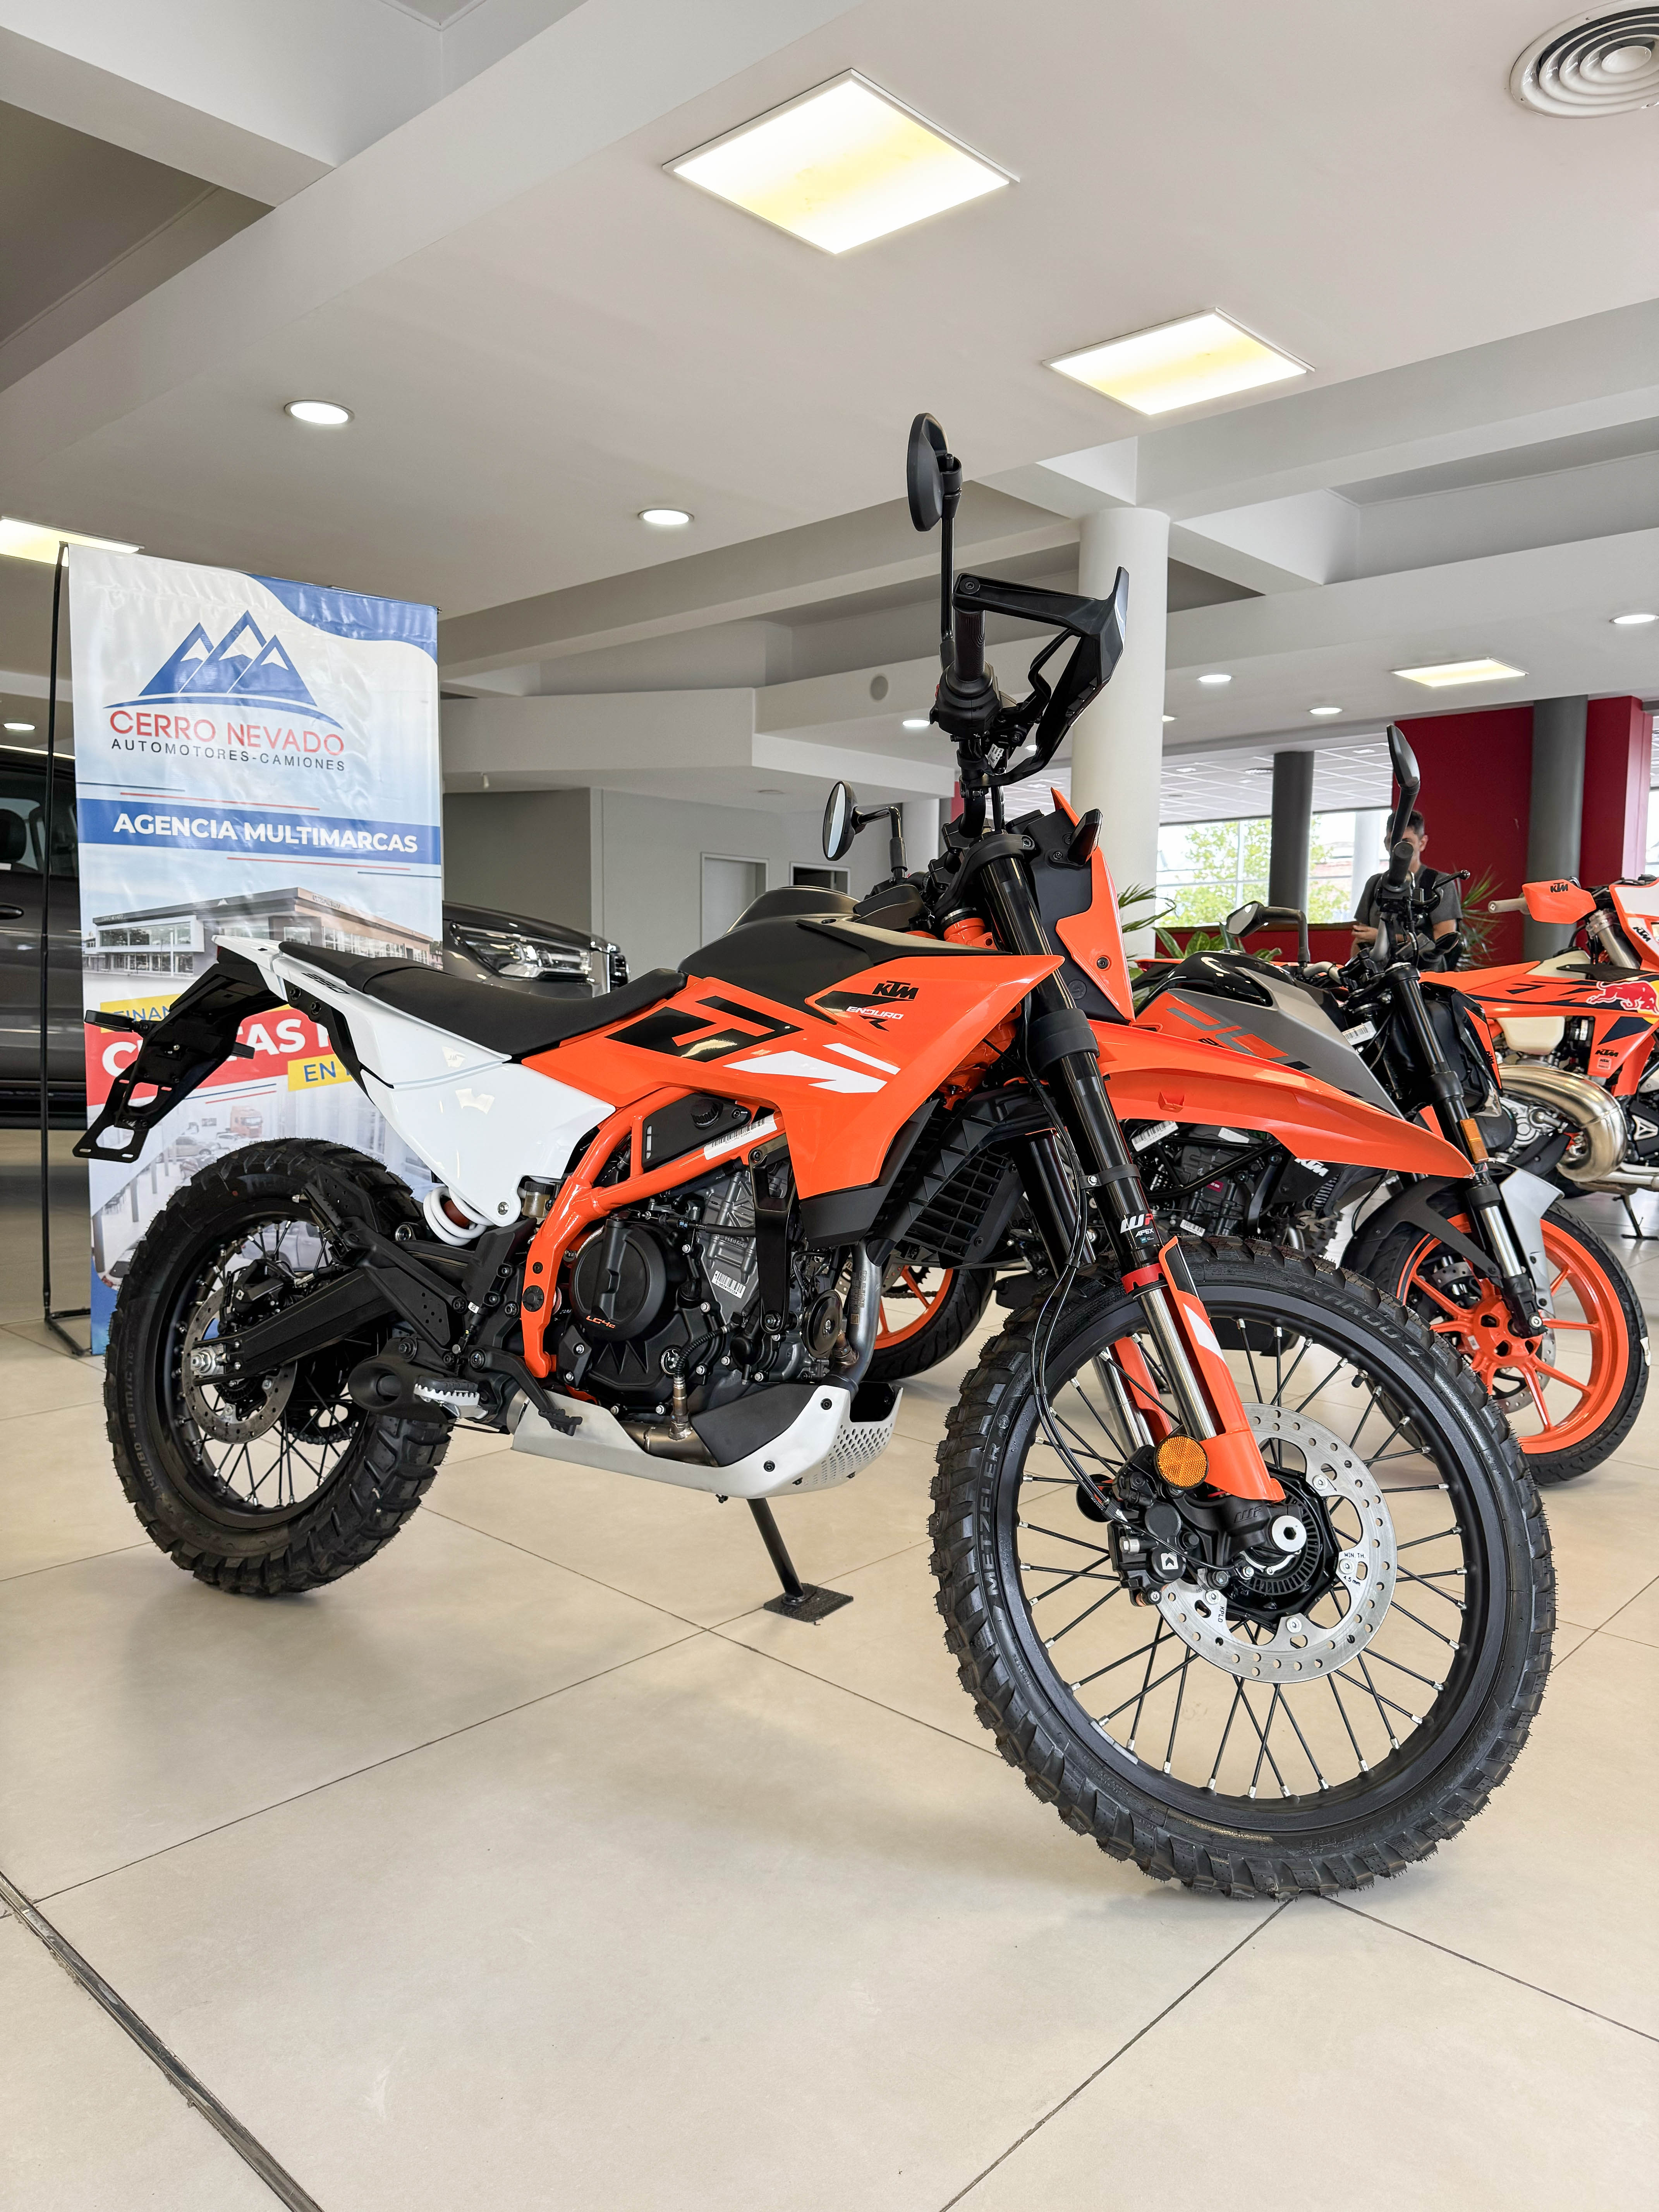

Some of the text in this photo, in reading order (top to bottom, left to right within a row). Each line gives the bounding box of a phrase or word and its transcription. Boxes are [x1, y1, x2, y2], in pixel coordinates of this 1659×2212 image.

[110, 710, 345, 756] CERRO NEVADO
[112, 738, 345, 771] AUTOMOTORES-CAMIONES
[113, 813, 418, 853] AGENCIA MULTIMARCAS
[1550, 882, 1568, 893] KTM
[1633, 927, 1651, 942] KTM
[872, 980, 919, 1000] KTM
[846, 1006, 904, 1020] ENDURO
[1595, 1049, 1619, 1057] KTM
[304, 1061, 336, 1082] EN
[1294, 1158, 1329, 1177] KTM
[1135, 1228, 1154, 1238] APEX
[979, 1443, 1001, 1596] METZELER
